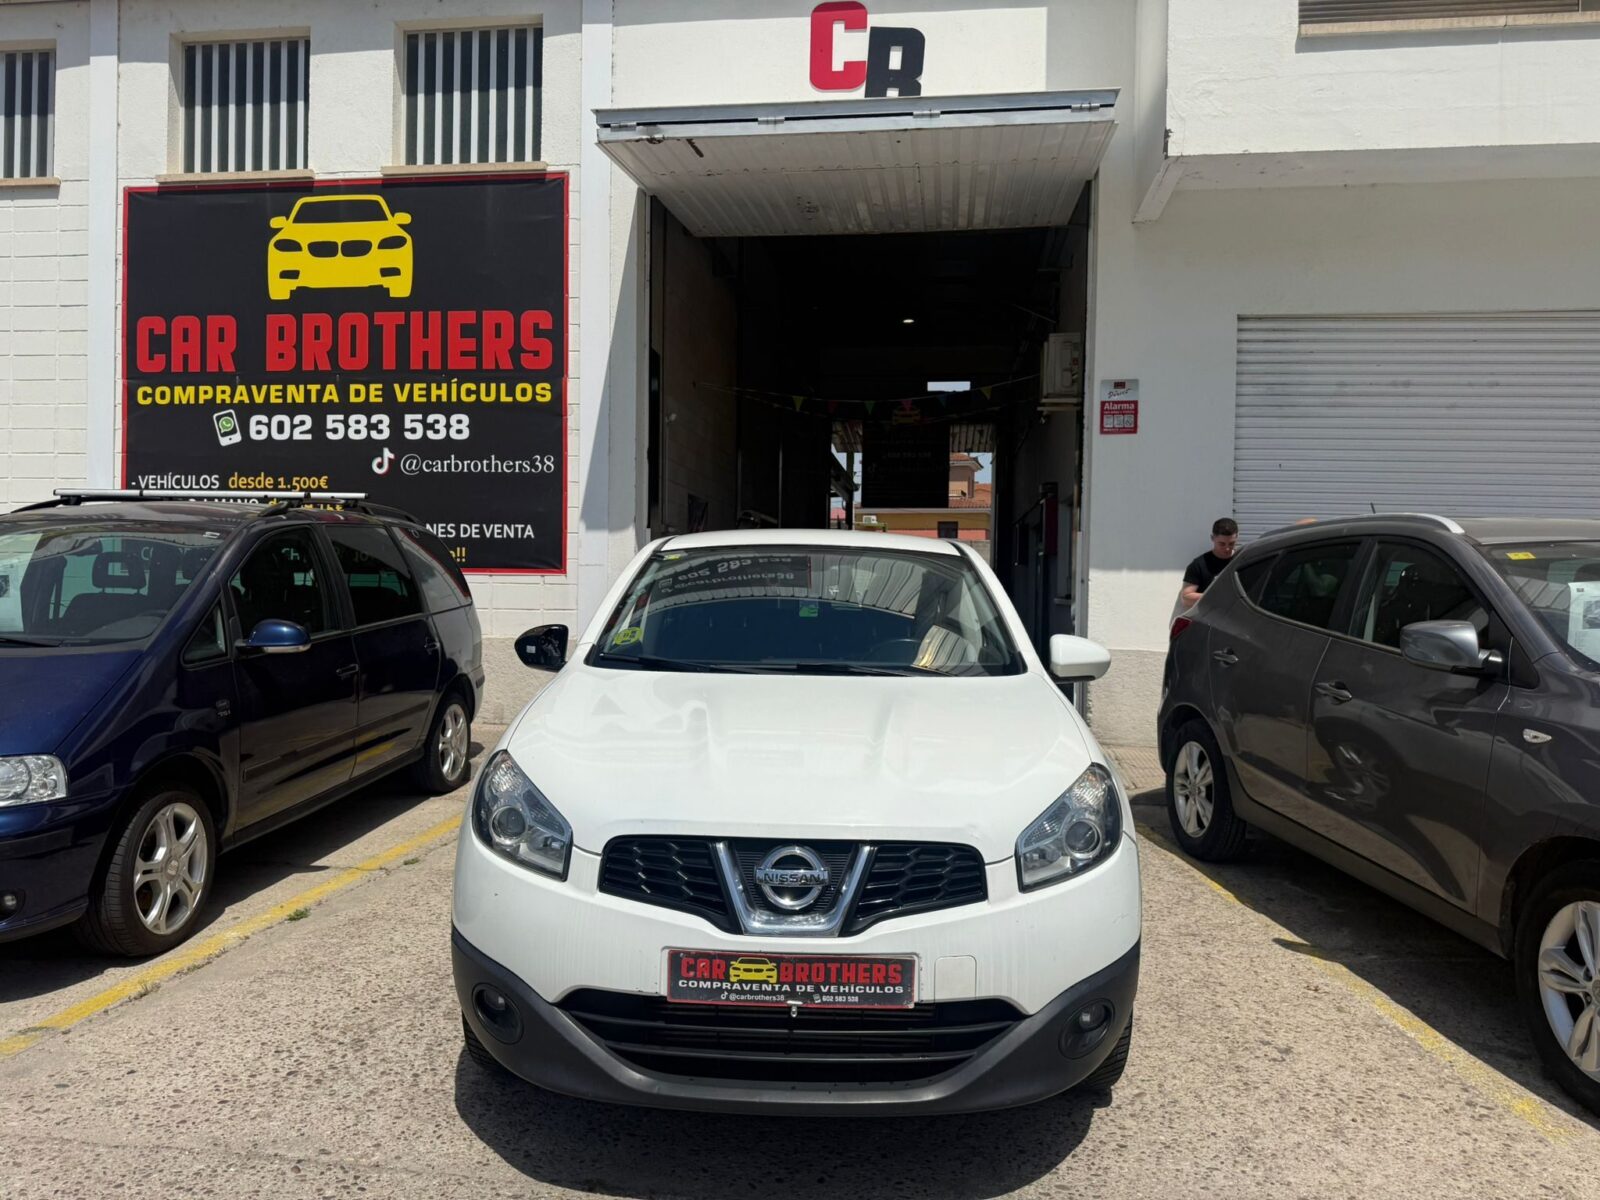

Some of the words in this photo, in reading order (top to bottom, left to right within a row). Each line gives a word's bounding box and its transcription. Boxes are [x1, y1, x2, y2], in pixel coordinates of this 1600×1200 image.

[809, 1, 926, 98] CR
[136, 315, 237, 372] CAR
[266, 310, 553, 371] BROTHERS
[137, 384, 339, 405] COMPRAVENTA
[349, 383, 383, 403] DE
[394, 378, 552, 403] VEHÍCULOS
[249, 414, 313, 441] 602
[325, 414, 391, 441] 583
[403, 413, 470, 440] 538
[400, 454, 555, 475] @carbrothers38
[138, 472, 220, 489] VEHÍCULOS
[228, 472, 274, 489] desde
[277, 475, 329, 492] 1.500€
[460, 524, 480, 538] DE
[483, 524, 535, 539] VENTA
[764, 873, 820, 883] NISSAN
[681, 957, 726, 979] CAR
[780, 963, 903, 984] BROTHERS
[678, 980, 791, 992] COMPRAVENTA
[796, 984, 815, 993] DE
[820, 983, 904, 994] VEHÍCULOS
